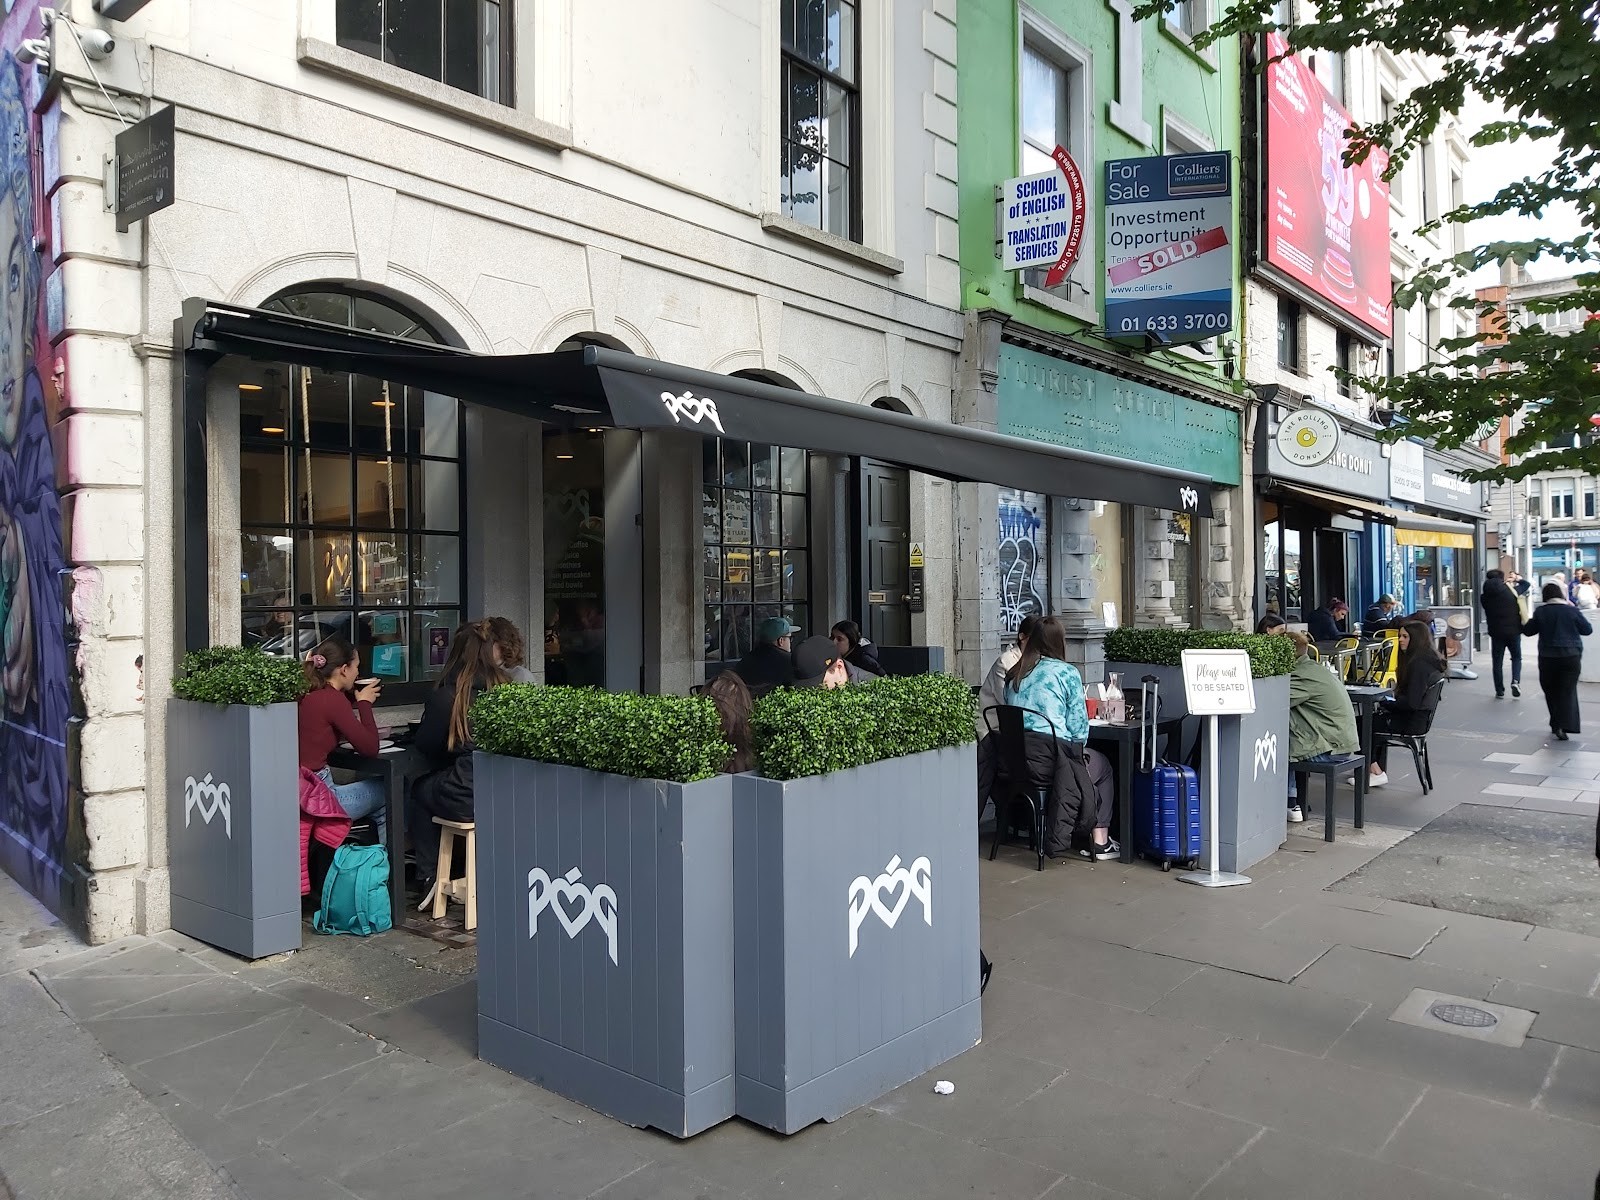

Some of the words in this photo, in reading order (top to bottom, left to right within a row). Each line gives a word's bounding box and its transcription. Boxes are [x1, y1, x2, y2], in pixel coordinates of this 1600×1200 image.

[1109, 162, 1141, 180] For
[1174, 163, 1221, 176] Colliers
[1174, 174, 1220, 182] INTERNATIONAL
[1016, 176, 1058, 199] SCHOOL
[1108, 181, 1150, 200] Sale
[1009, 202, 1020, 219] of
[1022, 193, 1066, 217] ENGLISH
[1111, 207, 1206, 227] Investment
[1007, 220, 1067, 246] TRANSLATION
[1015, 240, 1058, 262] SERVICES
[1137, 239, 1198, 273] SOLD
[1110, 283, 1173, 294] www.colliers.ie
[1121, 317, 1139, 331] 01
[1146, 315, 1178, 331] 633
[1184, 312, 1229, 330] 3700
[1285, 421, 1296, 433] THE
[1297, 414, 1329, 430] ROLLING
[1293, 451, 1322, 461] DONUT
[1348, 454, 1372, 475] DONUT
[1196, 664, 1220, 681] Please
[1221, 666, 1237, 678] wait
[1192, 684, 1203, 692] TO
[1216, 683, 1245, 692] SEATED
